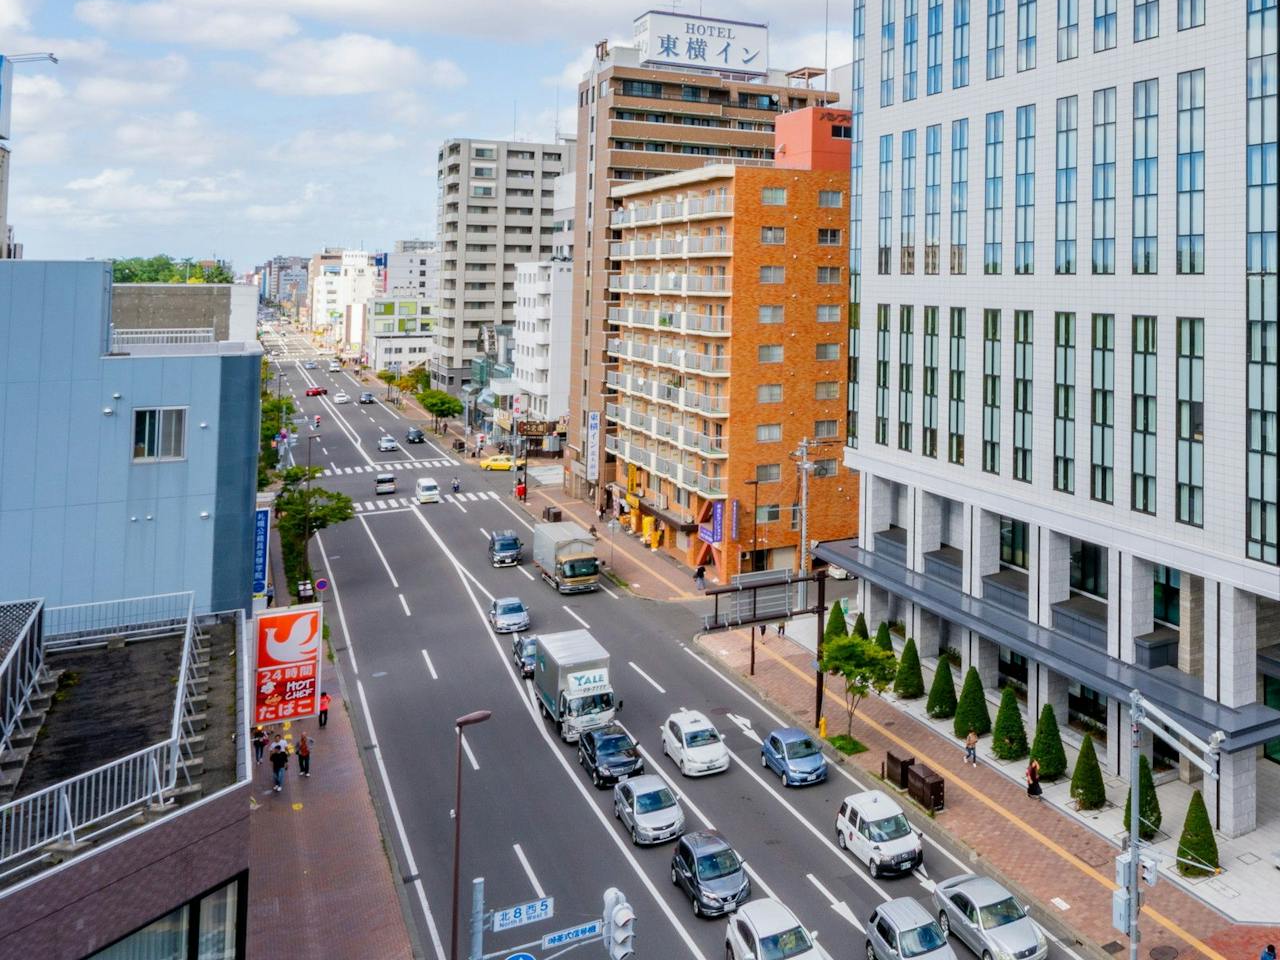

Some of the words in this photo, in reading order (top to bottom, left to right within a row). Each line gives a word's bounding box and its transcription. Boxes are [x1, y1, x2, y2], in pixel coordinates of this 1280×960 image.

[685, 23, 736, 40] HOTEL
[657, 34, 761, 65] 東横イン
[261, 664, 313, 683] 24時間
[573, 673, 604, 686] YALE
[286, 678, 315, 692] HOT
[285, 688, 314, 700] CHEF
[259, 699, 311, 720] たばこ
